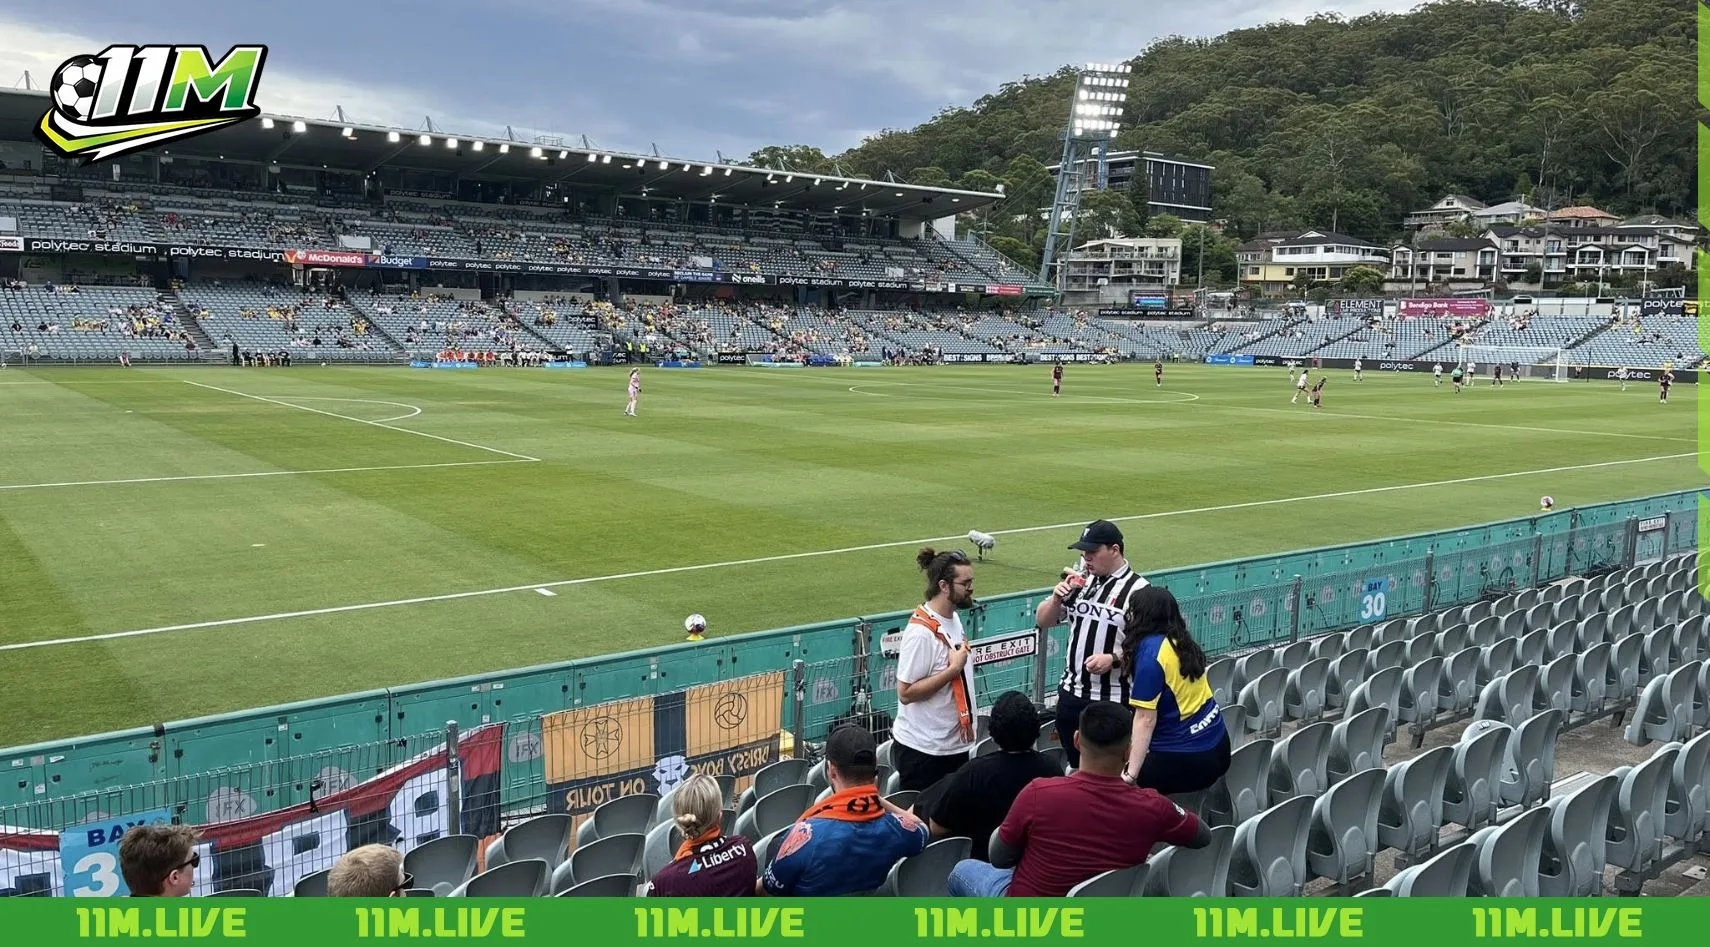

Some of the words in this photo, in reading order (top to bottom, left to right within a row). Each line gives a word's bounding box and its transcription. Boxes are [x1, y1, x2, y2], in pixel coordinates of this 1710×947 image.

[31, 240, 90, 252] polytec
[94, 241, 157, 254] stadium
[170, 246, 222, 258] polytec
[228, 249, 286, 261] stadium
[308, 254, 363, 264] McDonald's
[380, 255, 413, 267] Budget
[430, 260, 458, 268] polytec
[465, 261, 492, 269] polytec
[495, 263, 521, 271] polytec
[528, 264, 554, 272] polytec
[556, 265, 582, 274] polytec
[588, 267, 612, 275] polytec
[616, 268, 640, 277] polytec
[648, 269, 671, 278] polytec
[779, 276, 808, 285] polytec
[811, 278, 843, 286] stadium
[849, 280, 875, 289] polytec
[1340, 300, 1382, 309] ELEMENT
[1408, 301, 1432, 310] Bendigo
[1432, 301, 1449, 309] Bank
[1644, 299, 1683, 310] polyte
[720, 354, 745, 362] polytec
[943, 353, 960, 362] BEST
[963, 354, 983, 362] SIGNS
[1040, 353, 1055, 361] BEST
[1075, 353, 1090, 361] BEST
[1379, 361, 1414, 370] polytec
[1367, 581, 1383, 592] BAY
[1361, 592, 1386, 619] 30
[1068, 602, 1120, 621] SONY
[975, 646, 992, 656] RE
[1001, 638, 1031, 650] EXIT
[984, 649, 1015, 661] OBSTRUCT
[1015, 645, 1031, 654] GATE
[702, 842, 747, 868] Liberty
[73, 851, 120, 897] 3
